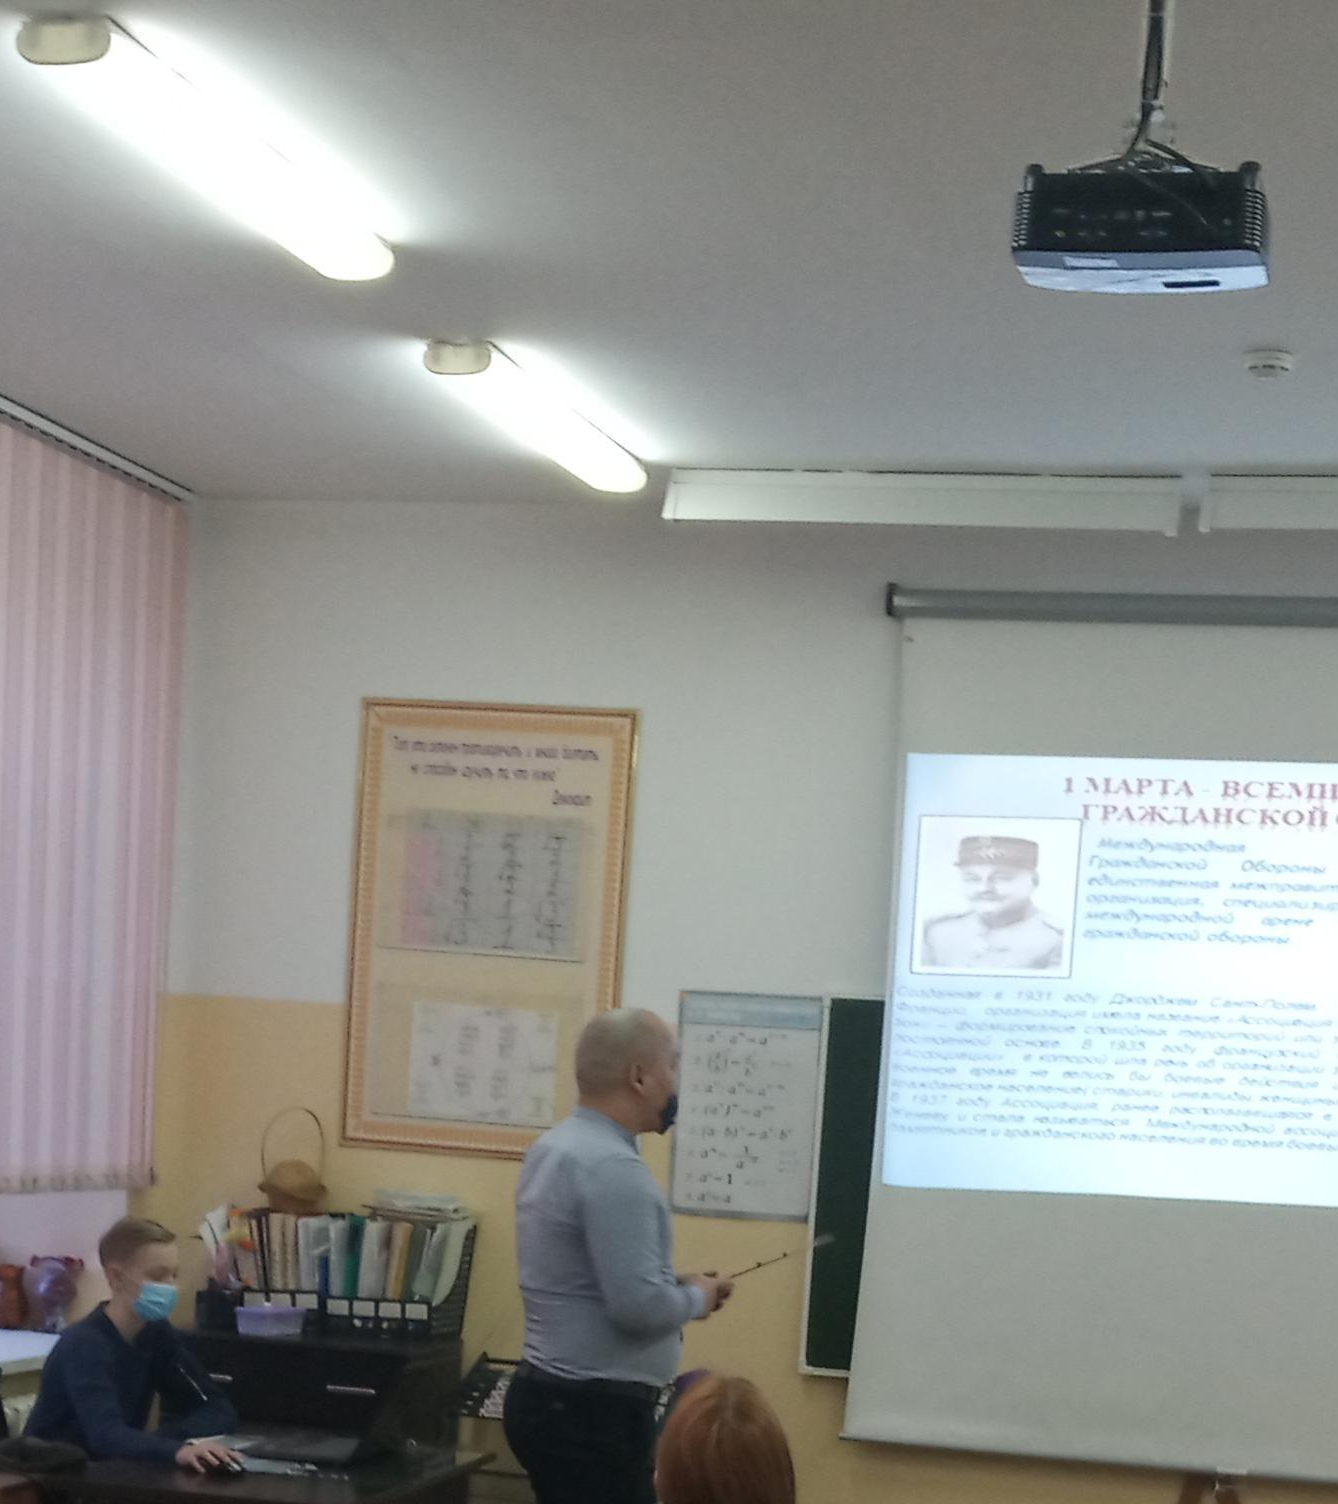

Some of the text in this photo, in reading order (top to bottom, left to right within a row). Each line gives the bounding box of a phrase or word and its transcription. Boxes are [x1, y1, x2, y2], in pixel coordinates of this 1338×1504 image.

[1063, 777, 1074, 793] 1
[1084, 777, 1194, 796] МАРТА
[1080, 804, 1328, 827] ГРАЖДАНСКОЙ
